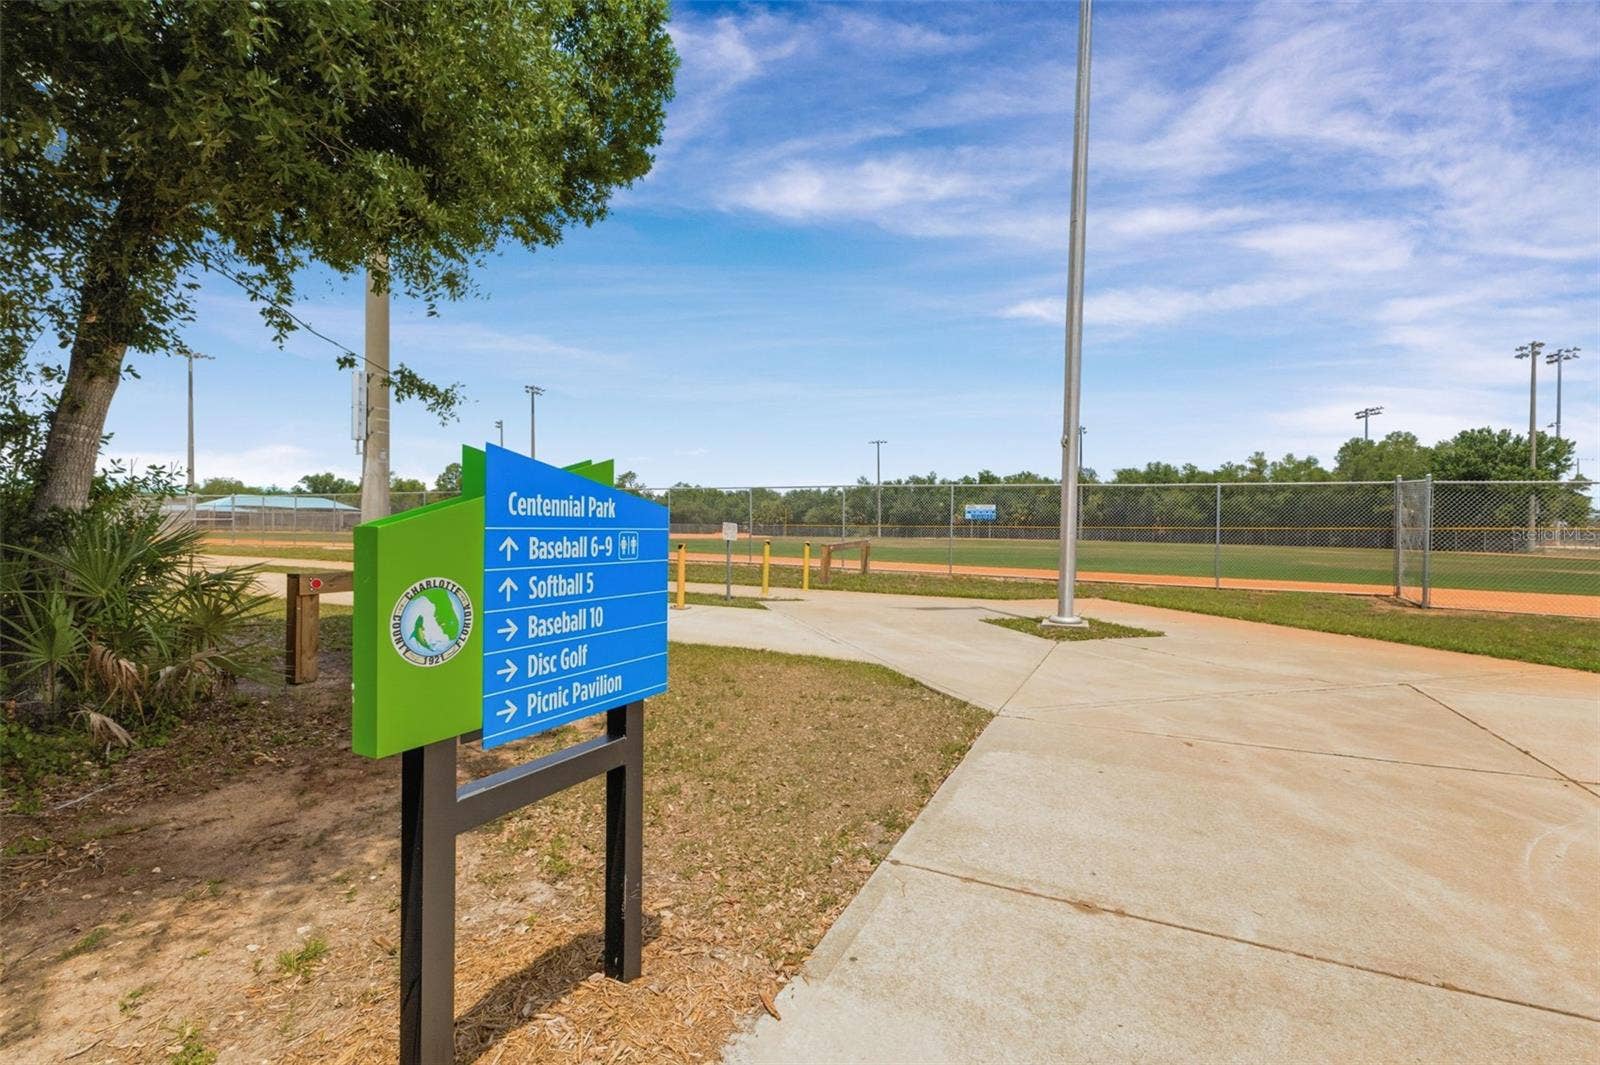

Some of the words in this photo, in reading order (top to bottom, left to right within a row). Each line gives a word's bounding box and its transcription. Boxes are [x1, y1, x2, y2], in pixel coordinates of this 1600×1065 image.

[508, 491, 585, 518] Centennial
[588, 495, 616, 519] Park
[528, 536, 587, 560] Baseball
[590, 536, 613, 557] 6-9
[405, 579, 462, 600] CHARLOTTE
[528, 573, 583, 600] Softball
[586, 572, 594, 593] 5
[392, 614, 411, 655] COUNTY
[455, 603, 472, 648] FLORIDA
[528, 608, 586, 639] Baseball
[590, 606, 604, 628] 10
[424, 653, 444, 665] 1921
[527, 652, 557, 678] Disc
[560, 644, 588, 671] Golf
[527, 685, 569, 717] Picnic
[572, 674, 622, 703] Pavilion
